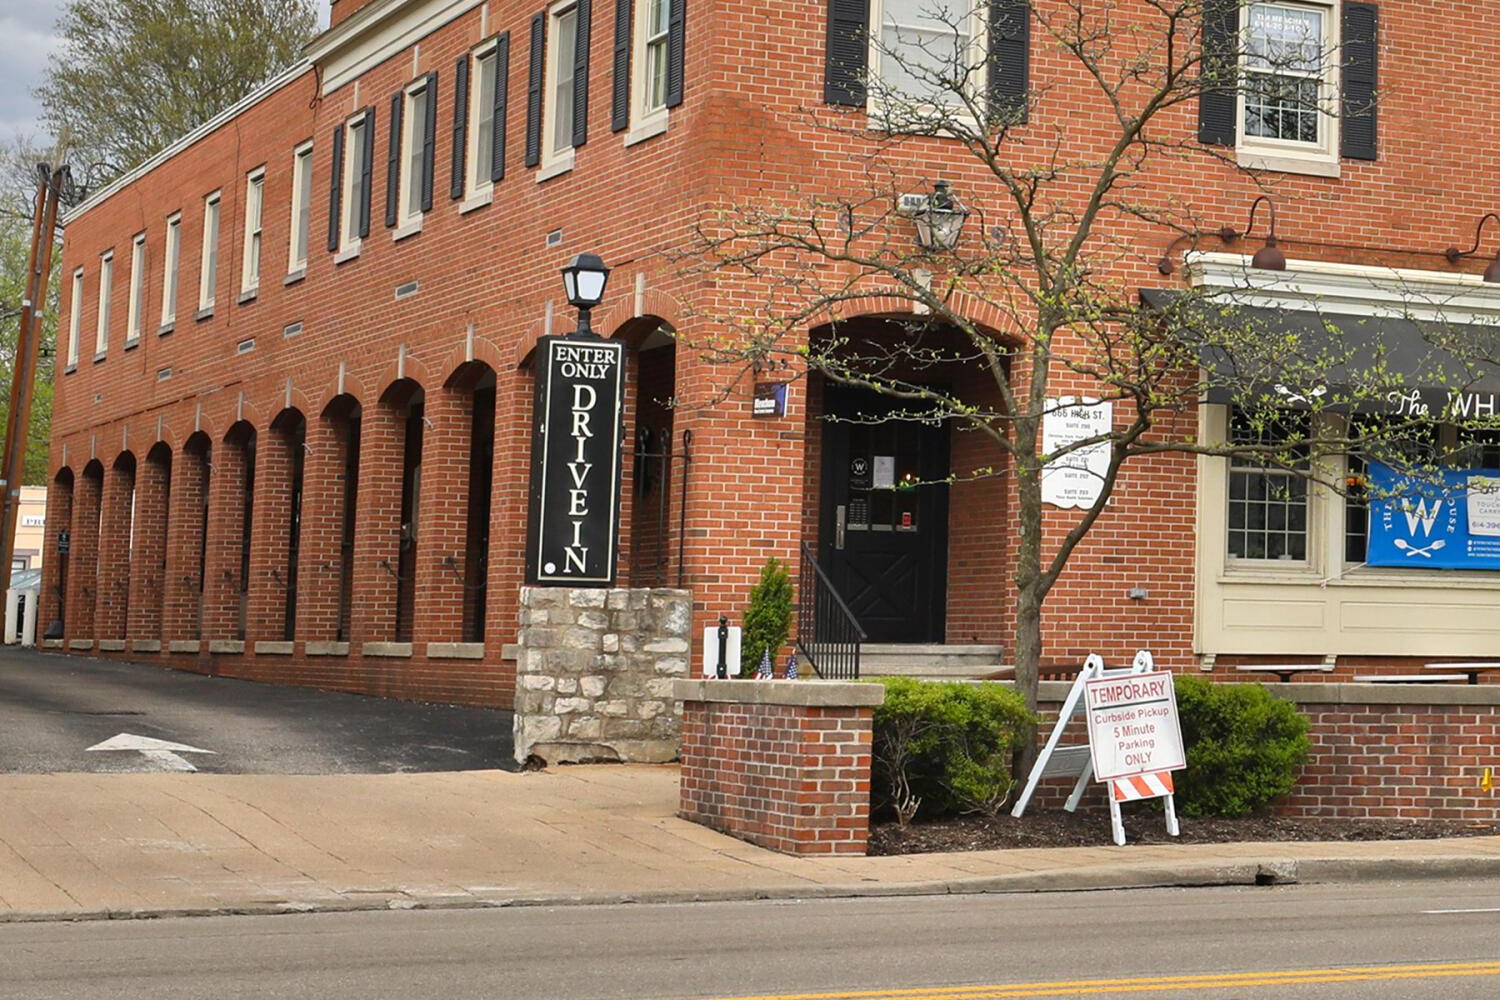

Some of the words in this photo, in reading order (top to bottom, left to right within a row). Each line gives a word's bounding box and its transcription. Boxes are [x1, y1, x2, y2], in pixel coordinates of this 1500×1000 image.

[556, 346, 616, 365] ENTER
[561, 362, 610, 380] ONLY
[1387, 391, 1428, 416] The
[1092, 410, 1105, 420] ST.
[854, 463, 865, 471] W
[1401, 497, 1442, 537] W
[1091, 680, 1166, 704] TEMPORARY
[1095, 711, 1136, 725] Curbside
[1138, 707, 1169, 719] Pickup
[1113, 727, 1120, 738] 5
[1122, 724, 1155, 737] Minute
[1118, 739, 1155, 751] Parking
[1125, 752, 1152, 766] ONLY
